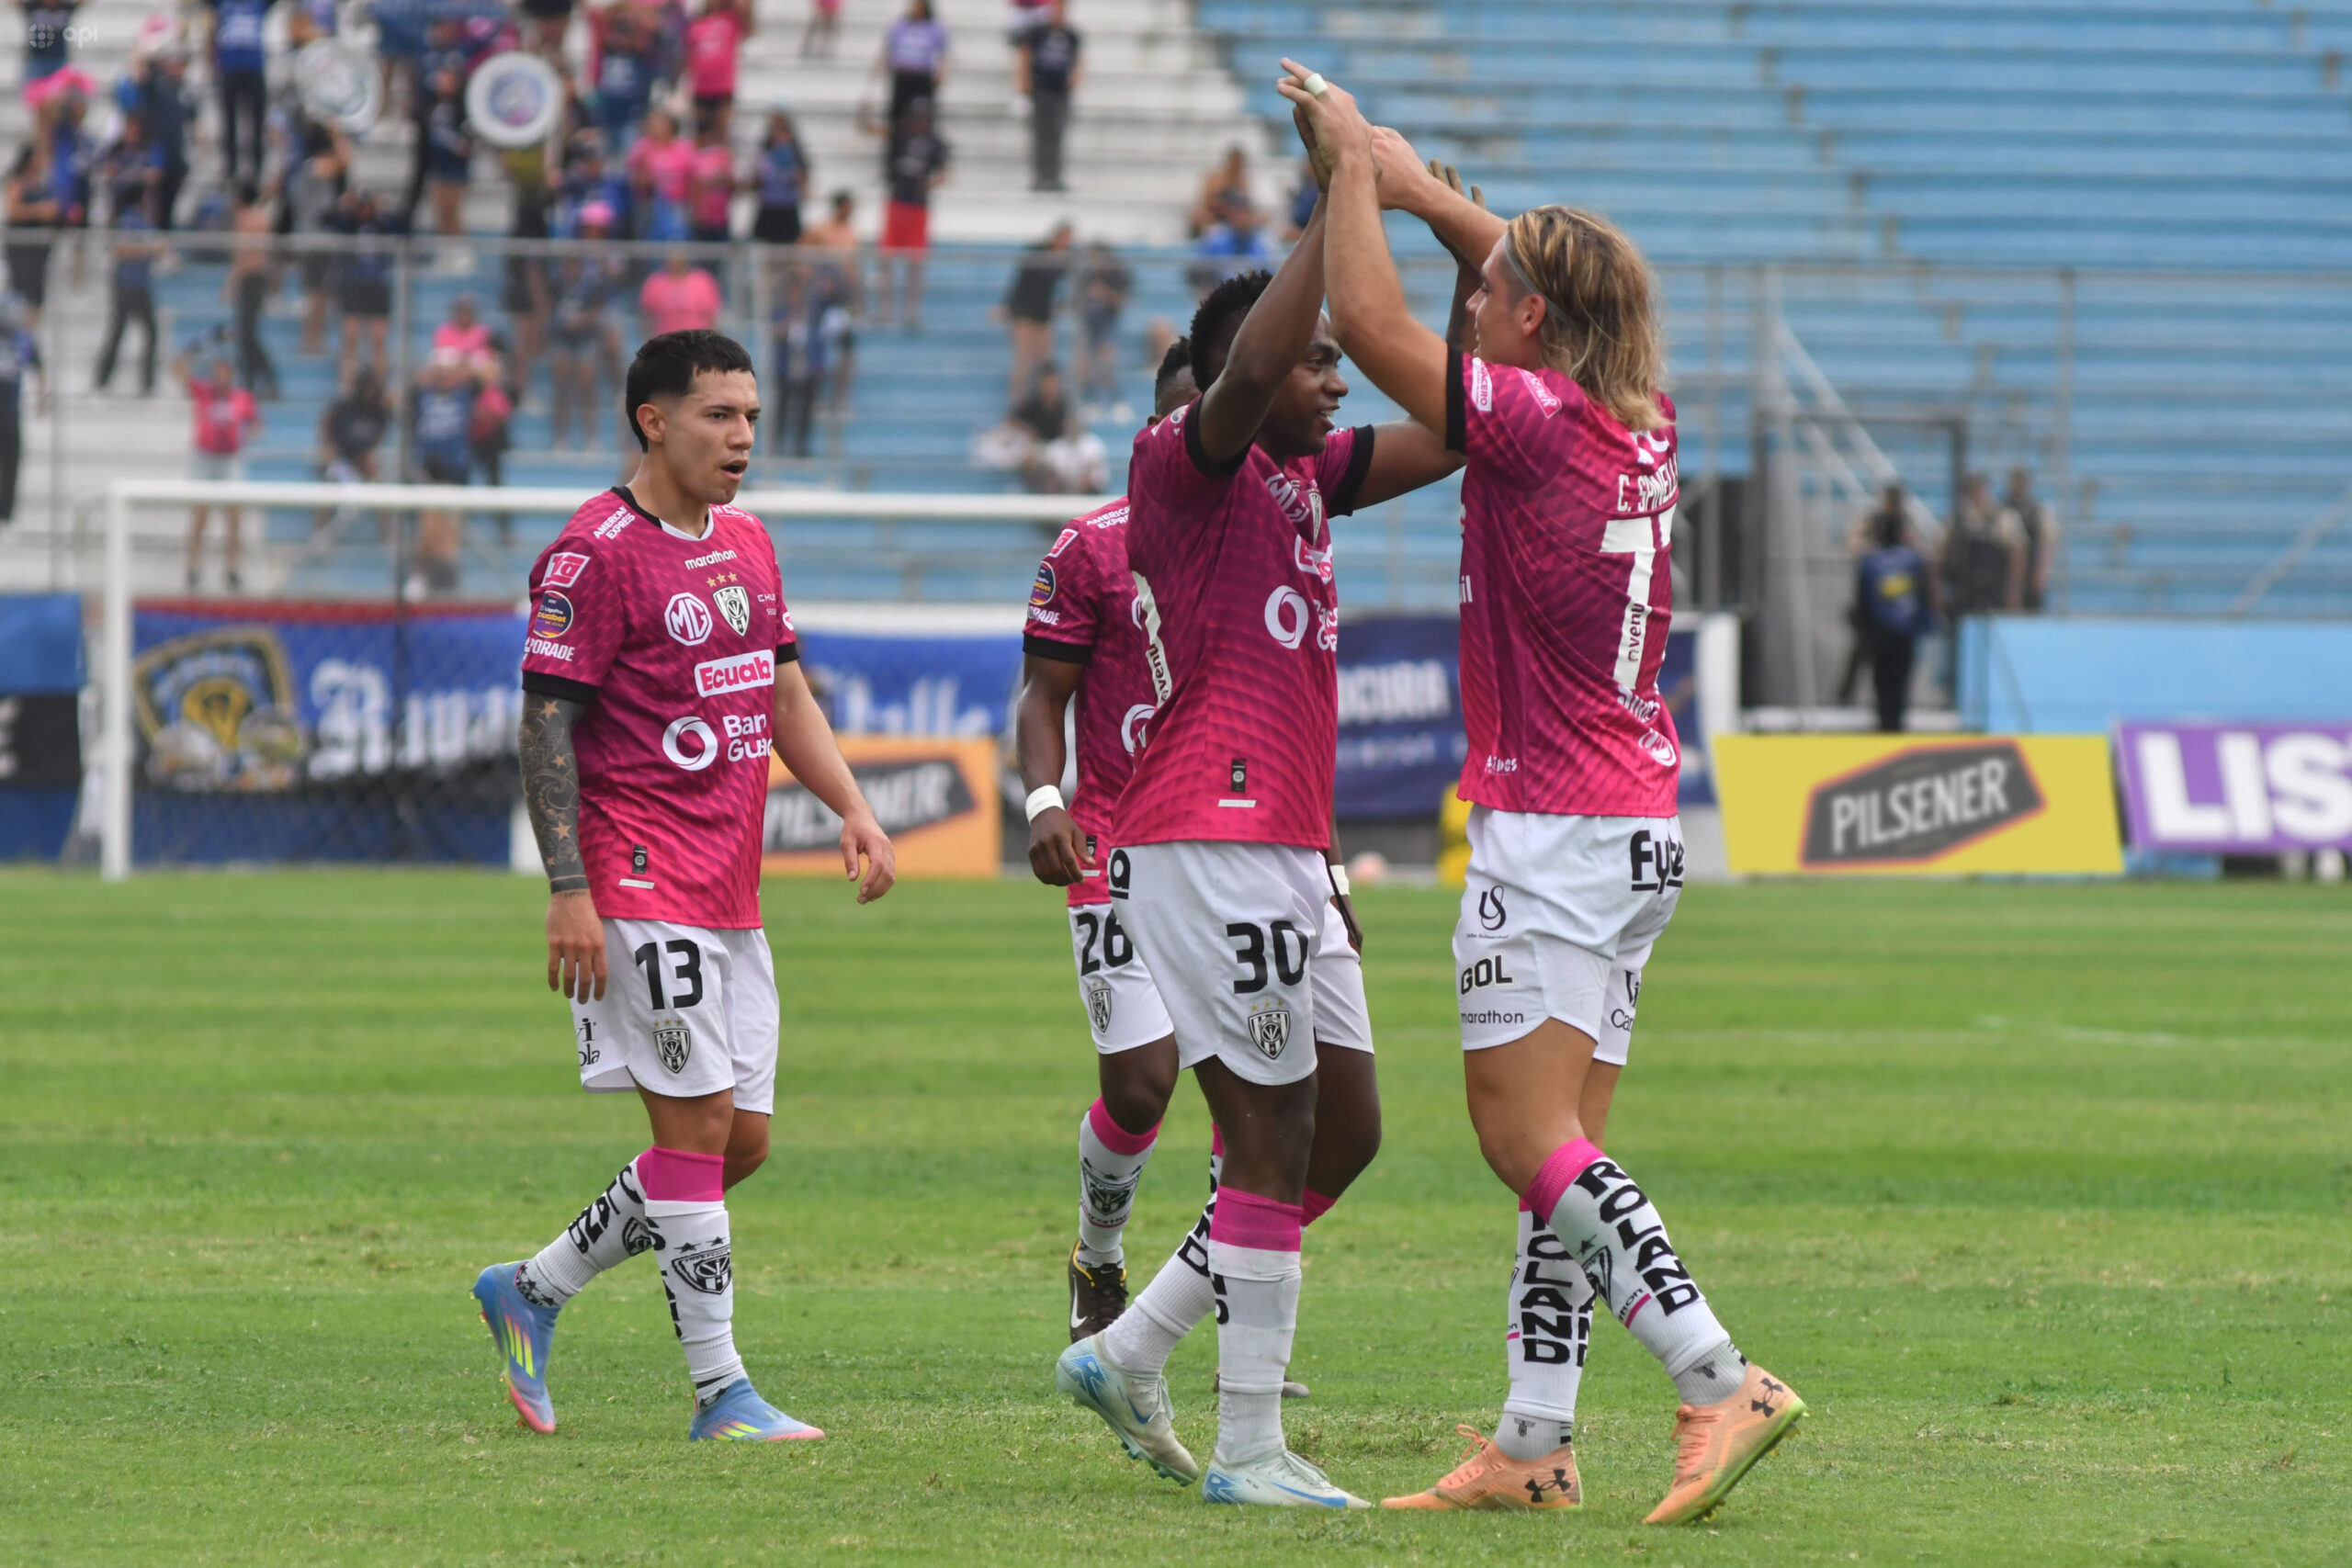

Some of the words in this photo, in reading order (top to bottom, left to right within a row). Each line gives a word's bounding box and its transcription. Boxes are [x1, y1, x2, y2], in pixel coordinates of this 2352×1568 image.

[1618, 474, 1632, 513] C.
[684, 550, 737, 570] marathon
[670, 602, 709, 641] MG
[1830, 755, 2009, 855] PILSENER
[1076, 909, 1134, 976] 26
[1226, 920, 1309, 995] 30
[635, 938, 703, 1010] 13
[1460, 953, 1514, 996] GOL
[1461, 1010, 1524, 1024] marathon
[1574, 1160, 1701, 1317] ROLAND
